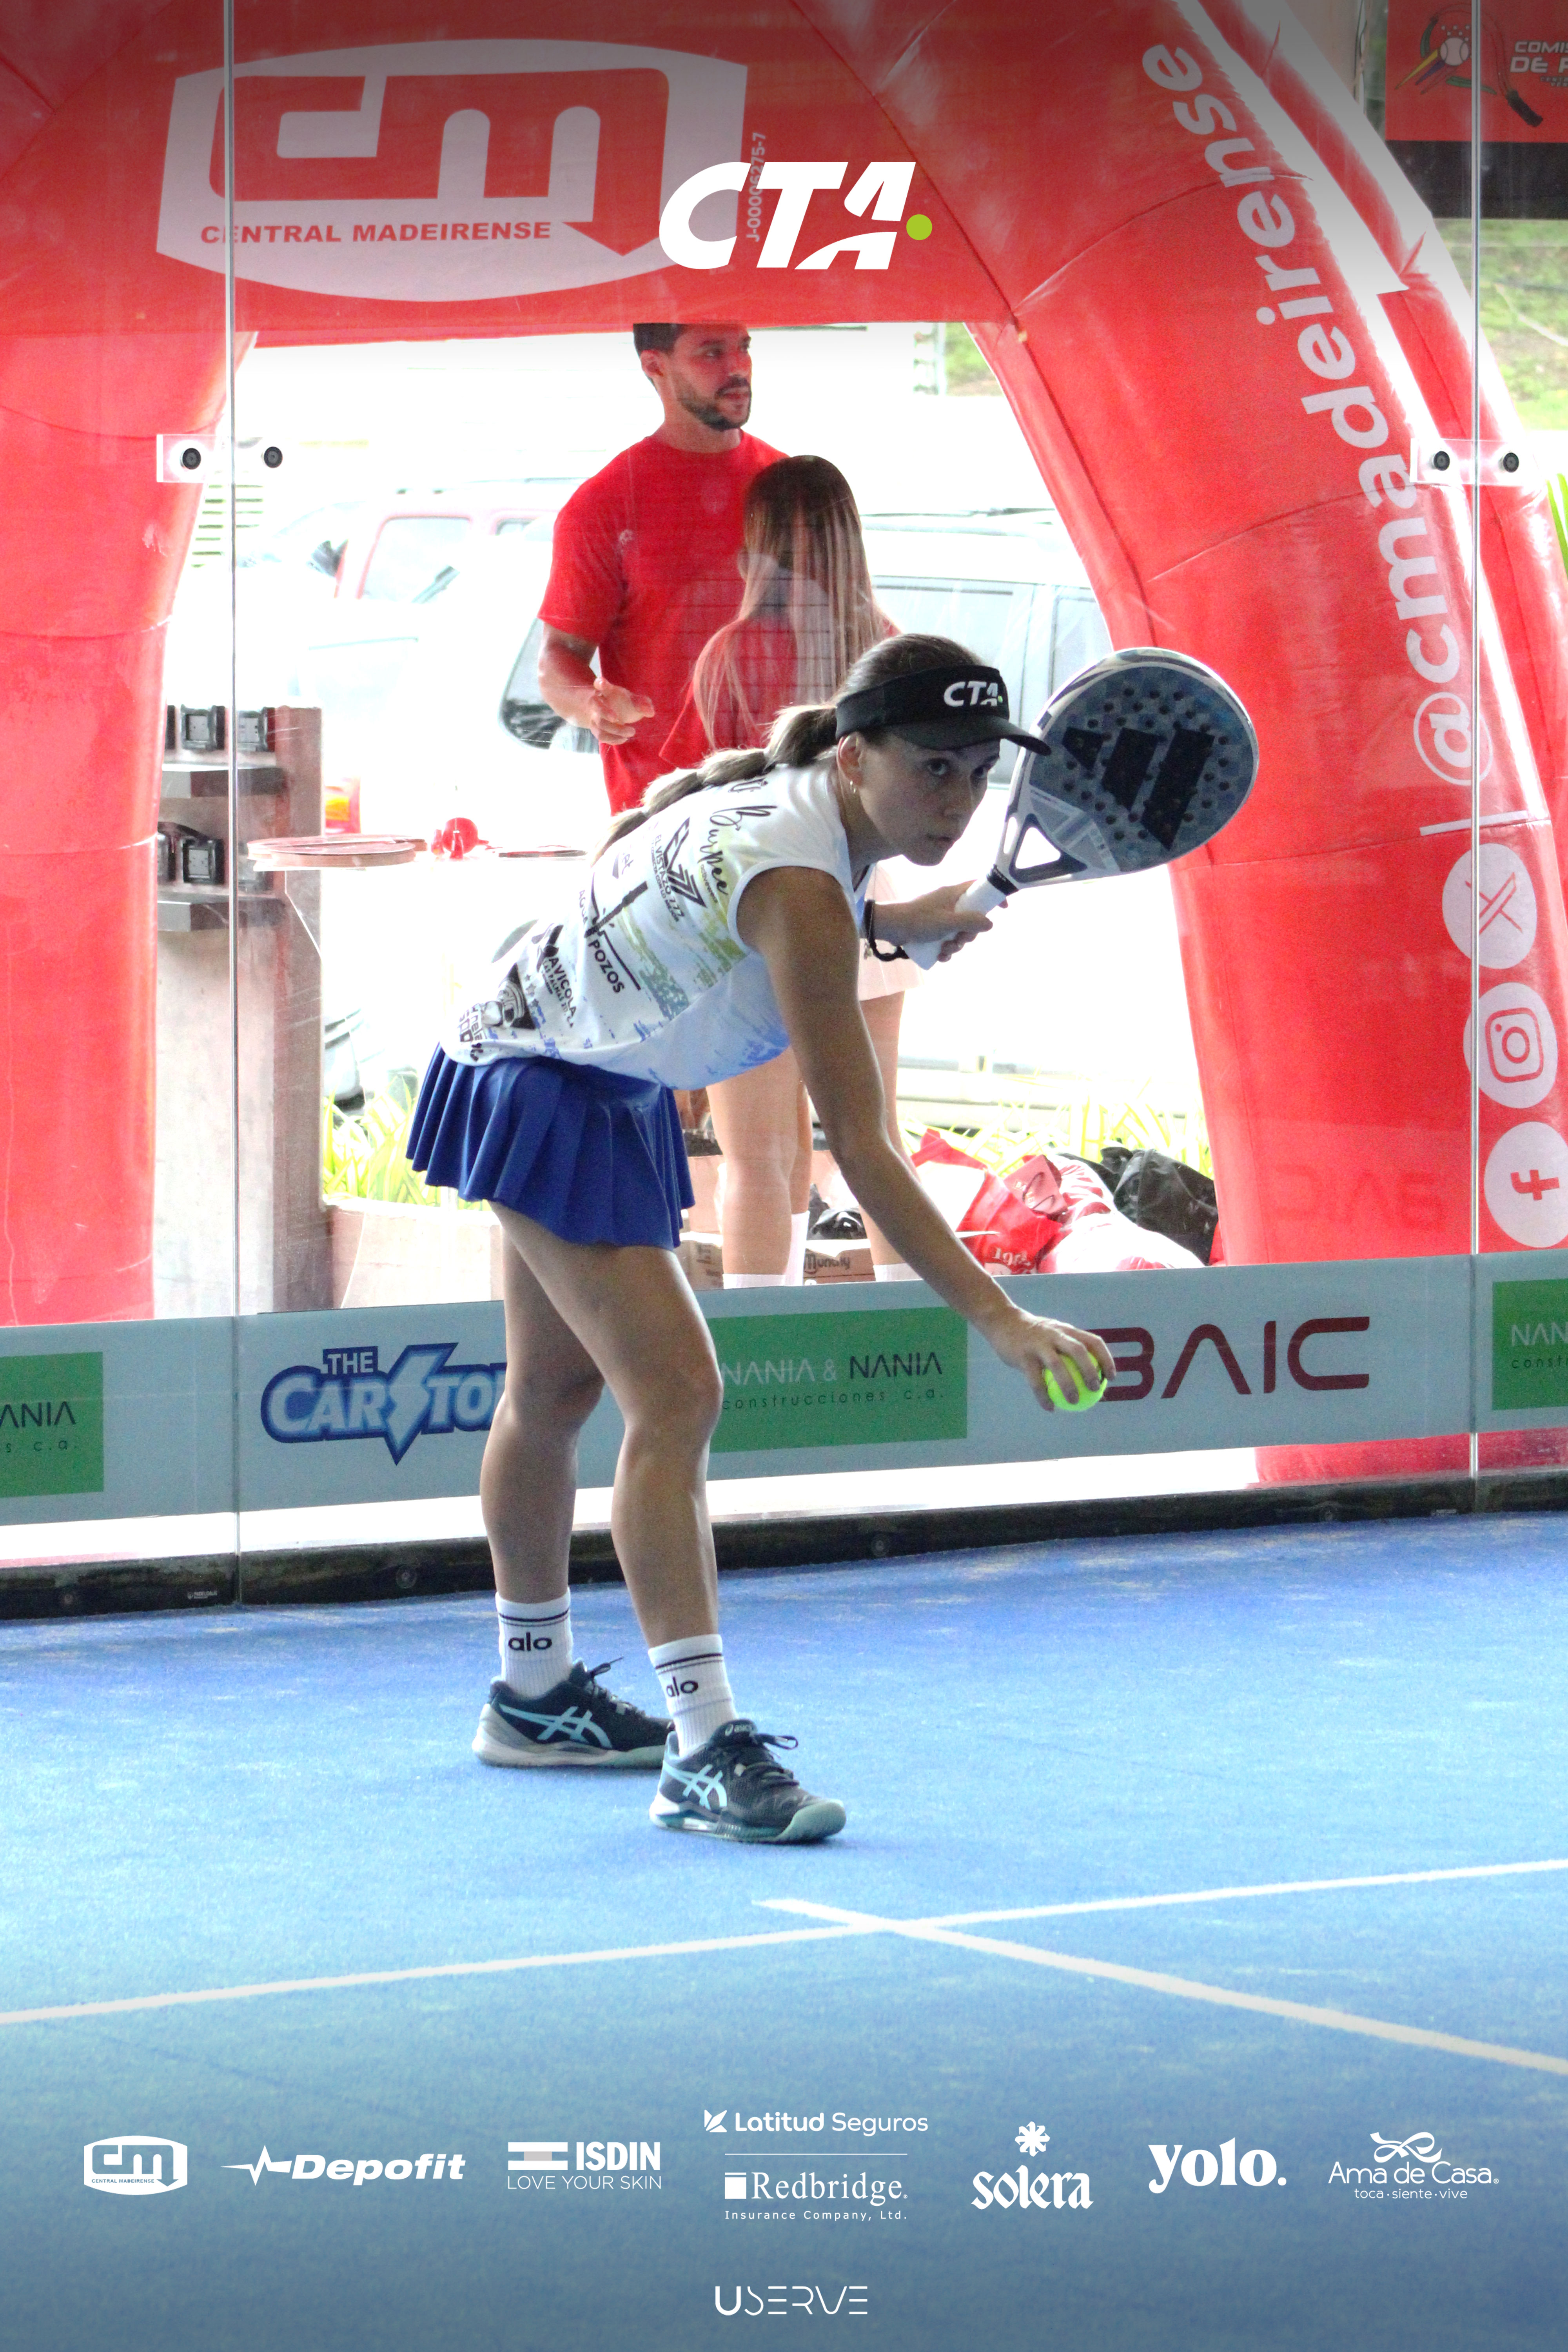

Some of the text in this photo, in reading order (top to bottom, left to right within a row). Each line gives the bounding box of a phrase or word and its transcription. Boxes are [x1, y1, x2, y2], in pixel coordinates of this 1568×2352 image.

[1514, 41, 1568, 53] COMI
[1509, 56, 1548, 73] DE
[353, 221, 551, 241] MADEIRENSE
[1142, 44, 1493, 786] @cmadeirense
[655, 834, 662, 846] EL
[655, 846, 671, 895] VISTAZO
[588, 939, 624, 993] POZOS
[549, 957, 577, 1017] AVICOLA
[1512, 1321, 1568, 1346] NAN
[327, 1352, 373, 1375] THE
[720, 1352, 942, 1385] NANIA & NANIA
[722, 1389, 885, 1410] construcciones
[0, 1401, 76, 1428] ANIA
[508, 1632, 552, 1651] alo
[666, 1676, 699, 1697] alo
